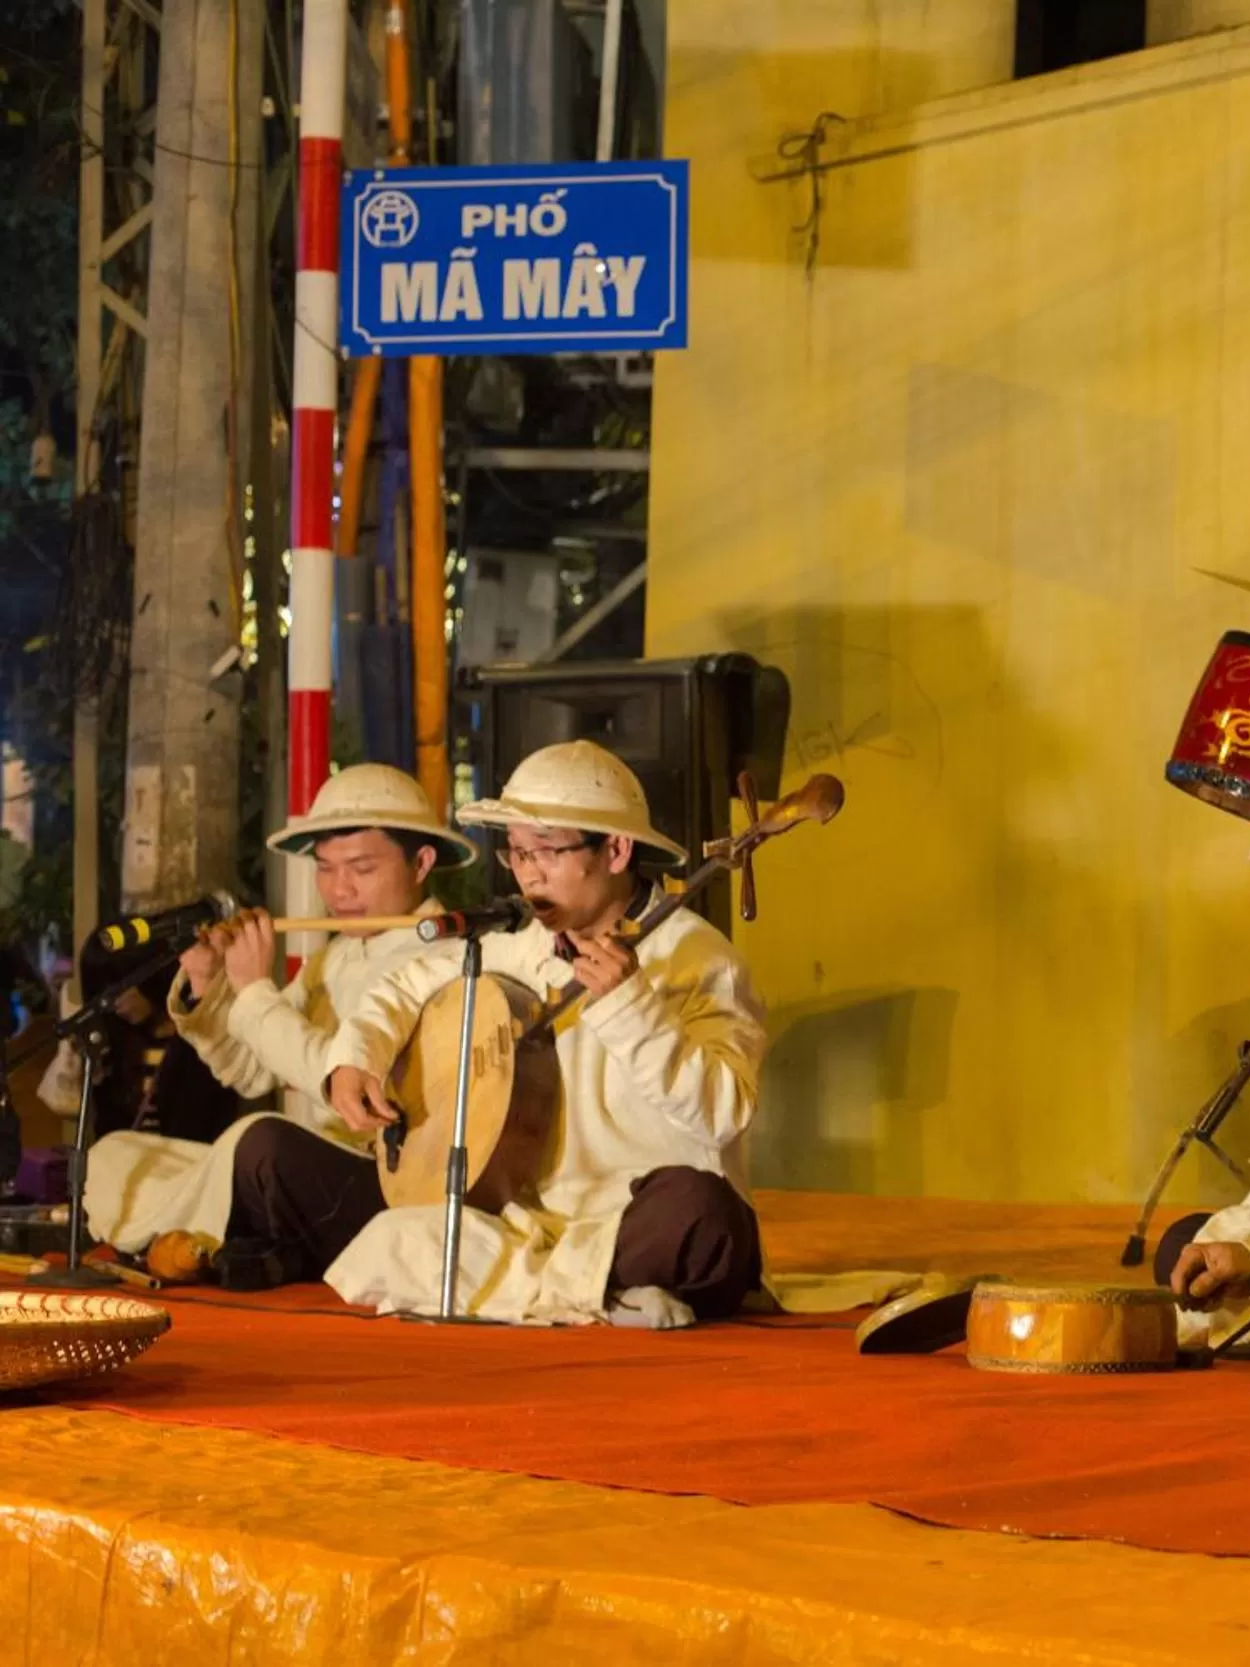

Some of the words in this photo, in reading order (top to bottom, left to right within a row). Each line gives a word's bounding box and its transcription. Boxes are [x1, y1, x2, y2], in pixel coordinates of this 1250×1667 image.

[461, 188, 568, 238] PHỐ
[380, 247, 484, 323] MÃ
[502, 242, 647, 321] MÂY
